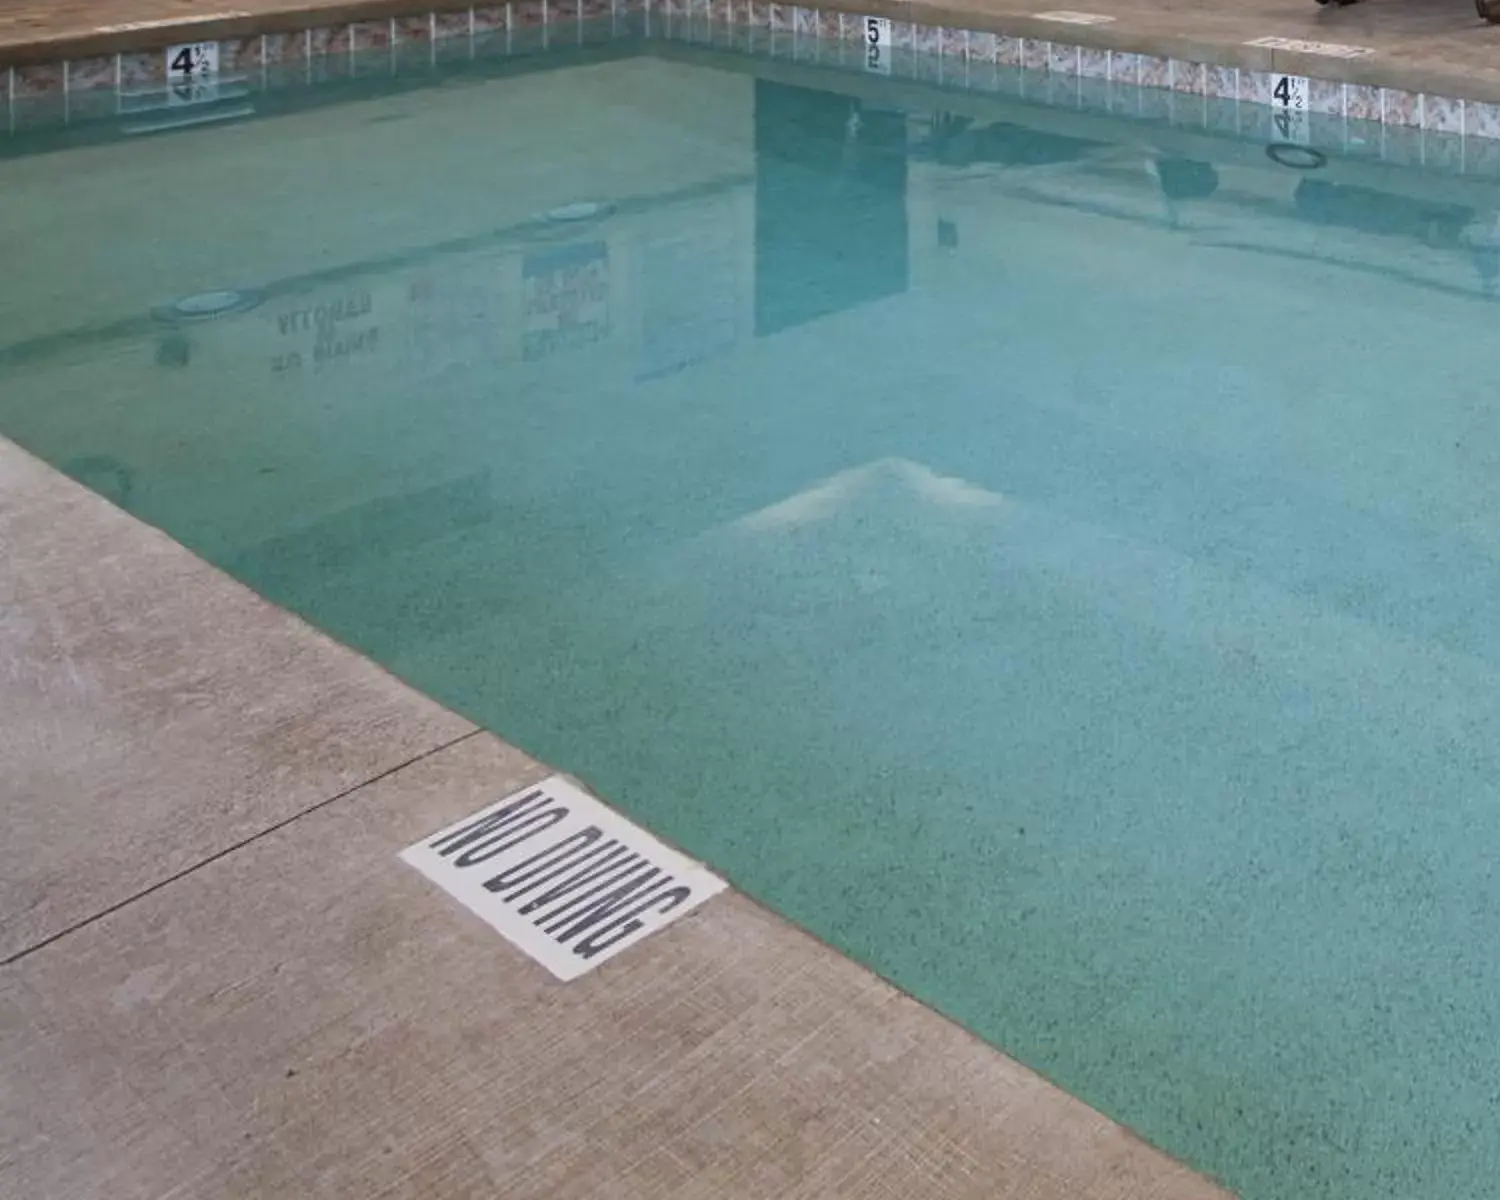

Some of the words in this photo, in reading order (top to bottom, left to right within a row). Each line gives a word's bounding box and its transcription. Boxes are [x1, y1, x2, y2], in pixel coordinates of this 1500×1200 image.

[867, 19, 879, 43] 5
[171, 47, 195, 74] 4
[1274, 77, 1290, 106] 4
[428, 790, 570, 869] NO
[481, 824, 692, 960] DIVING
